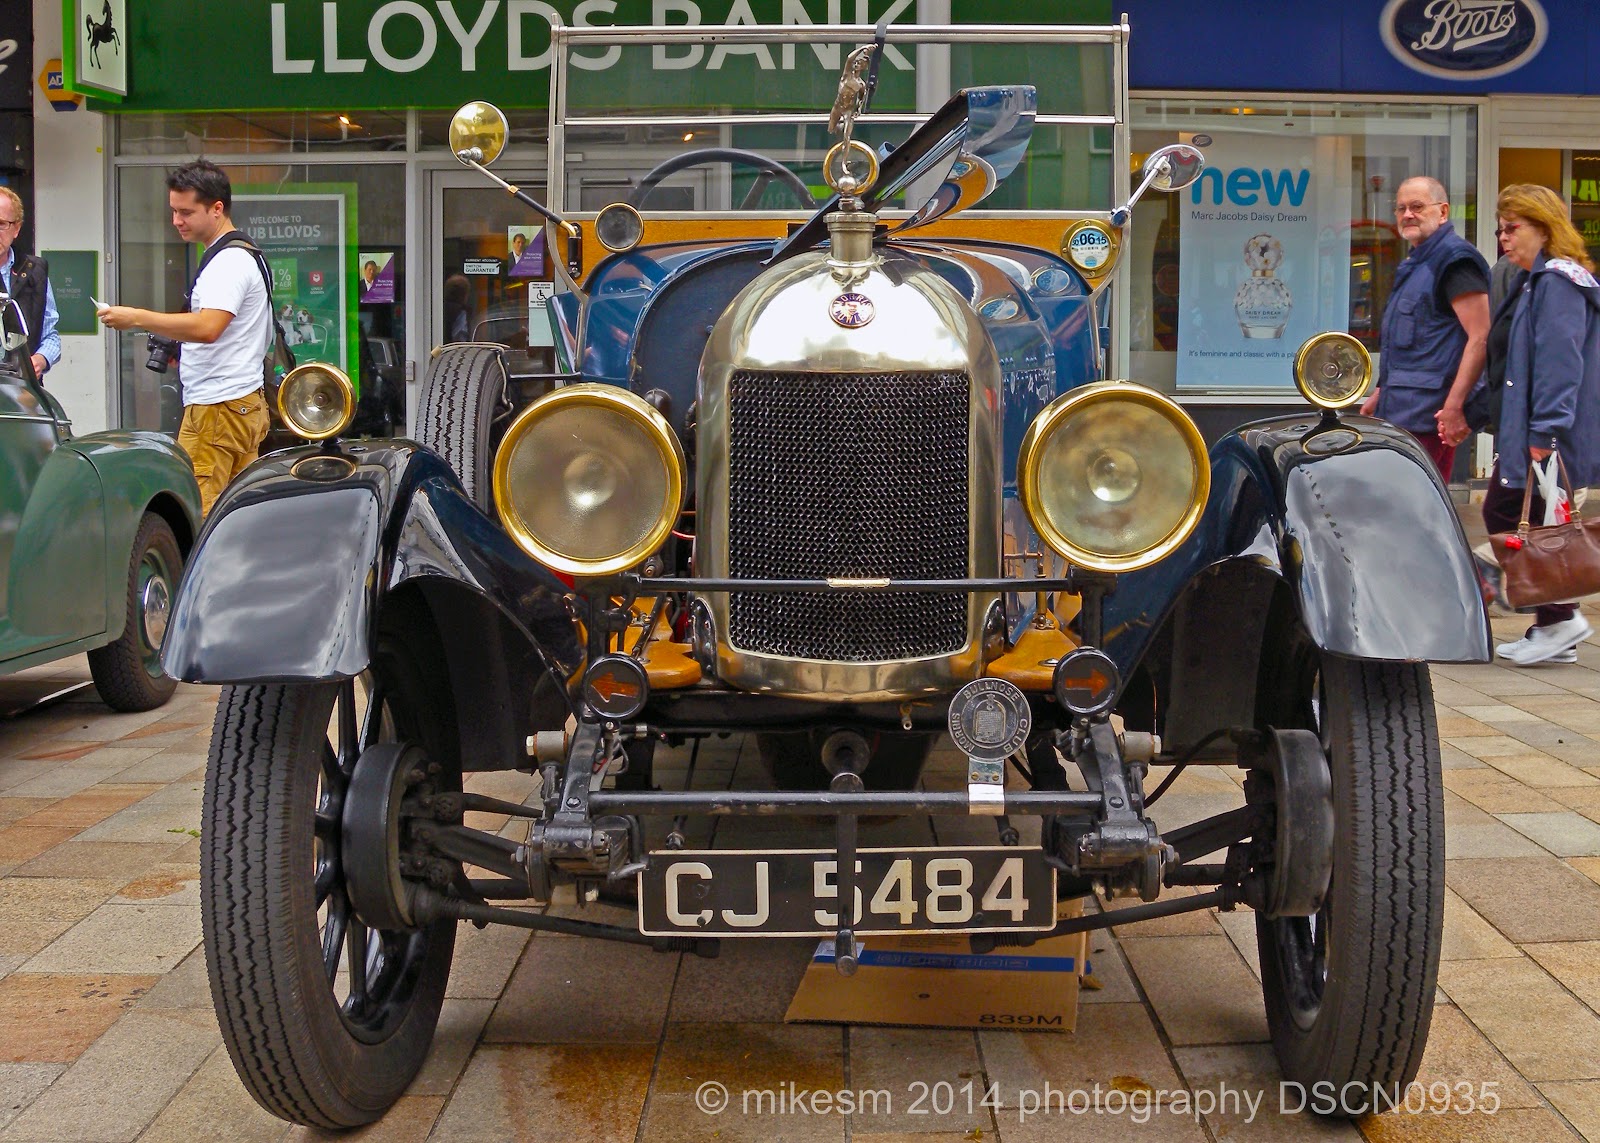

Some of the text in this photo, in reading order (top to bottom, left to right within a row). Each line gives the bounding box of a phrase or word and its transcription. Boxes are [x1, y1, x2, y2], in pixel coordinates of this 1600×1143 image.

[1411, 0, 1517, 51] Boots
[271, 0, 915, 73] LLOYDS BANK
[48, 75, 63, 86] AD
[1191, 166, 1311, 207] new
[249, 215, 302, 225] WELCOME TO
[1191, 210, 1307, 223] Marc Jacobs Daisy Dream
[268, 224, 321, 239] LLOYDS
[1199, 350, 1228, 358] feminine
[1229, 350, 1242, 358] and
[963, 682, 1020, 702] BULLNOSE
[952, 712, 1028, 754] MORRIS CLUB
[665, 857, 1030, 927] CJ 5484
[979, 1013, 1063, 1026] 839M
